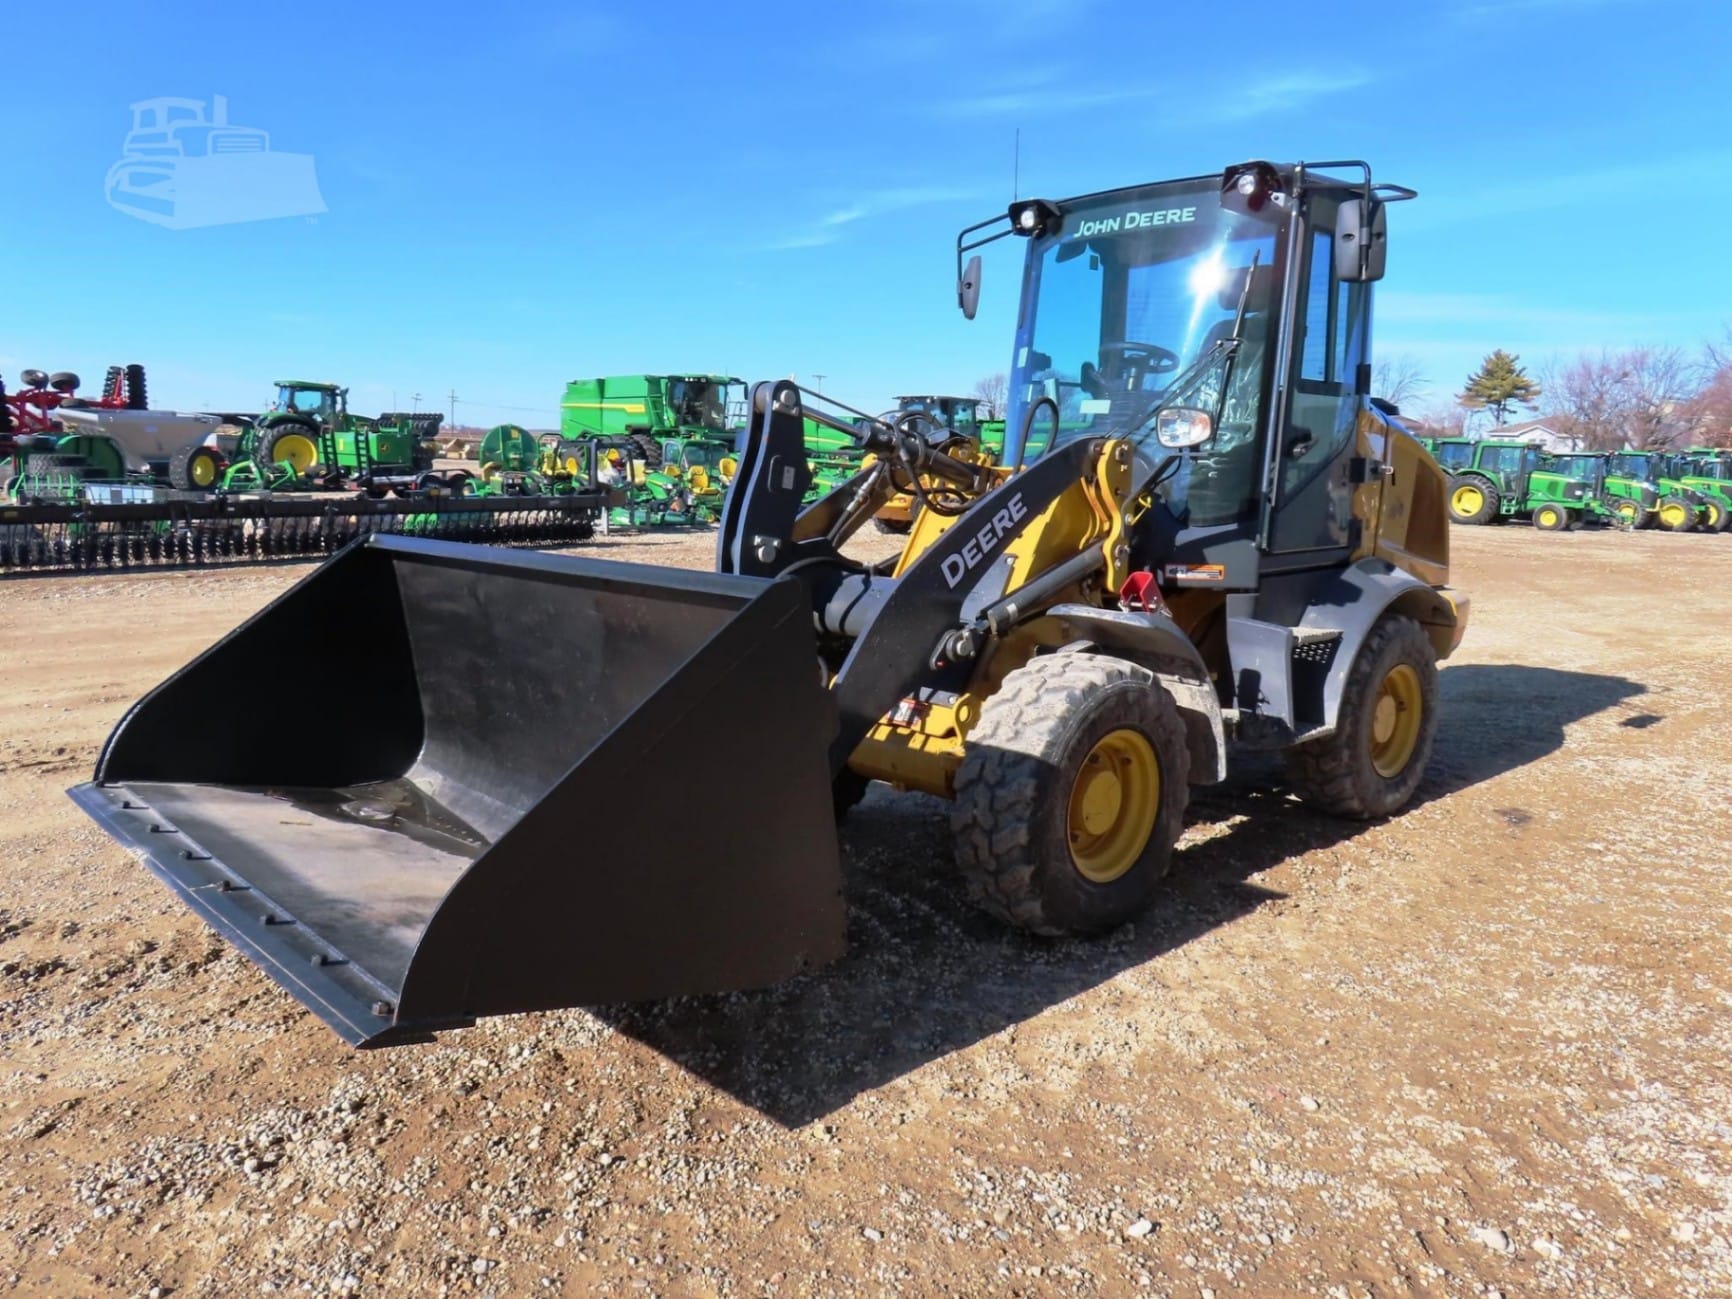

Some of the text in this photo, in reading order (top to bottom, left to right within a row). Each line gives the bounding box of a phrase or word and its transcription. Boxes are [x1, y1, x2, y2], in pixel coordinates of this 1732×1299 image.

[1073, 207, 1197, 238] JOHN DEERE
[940, 491, 1028, 590] DEERE
